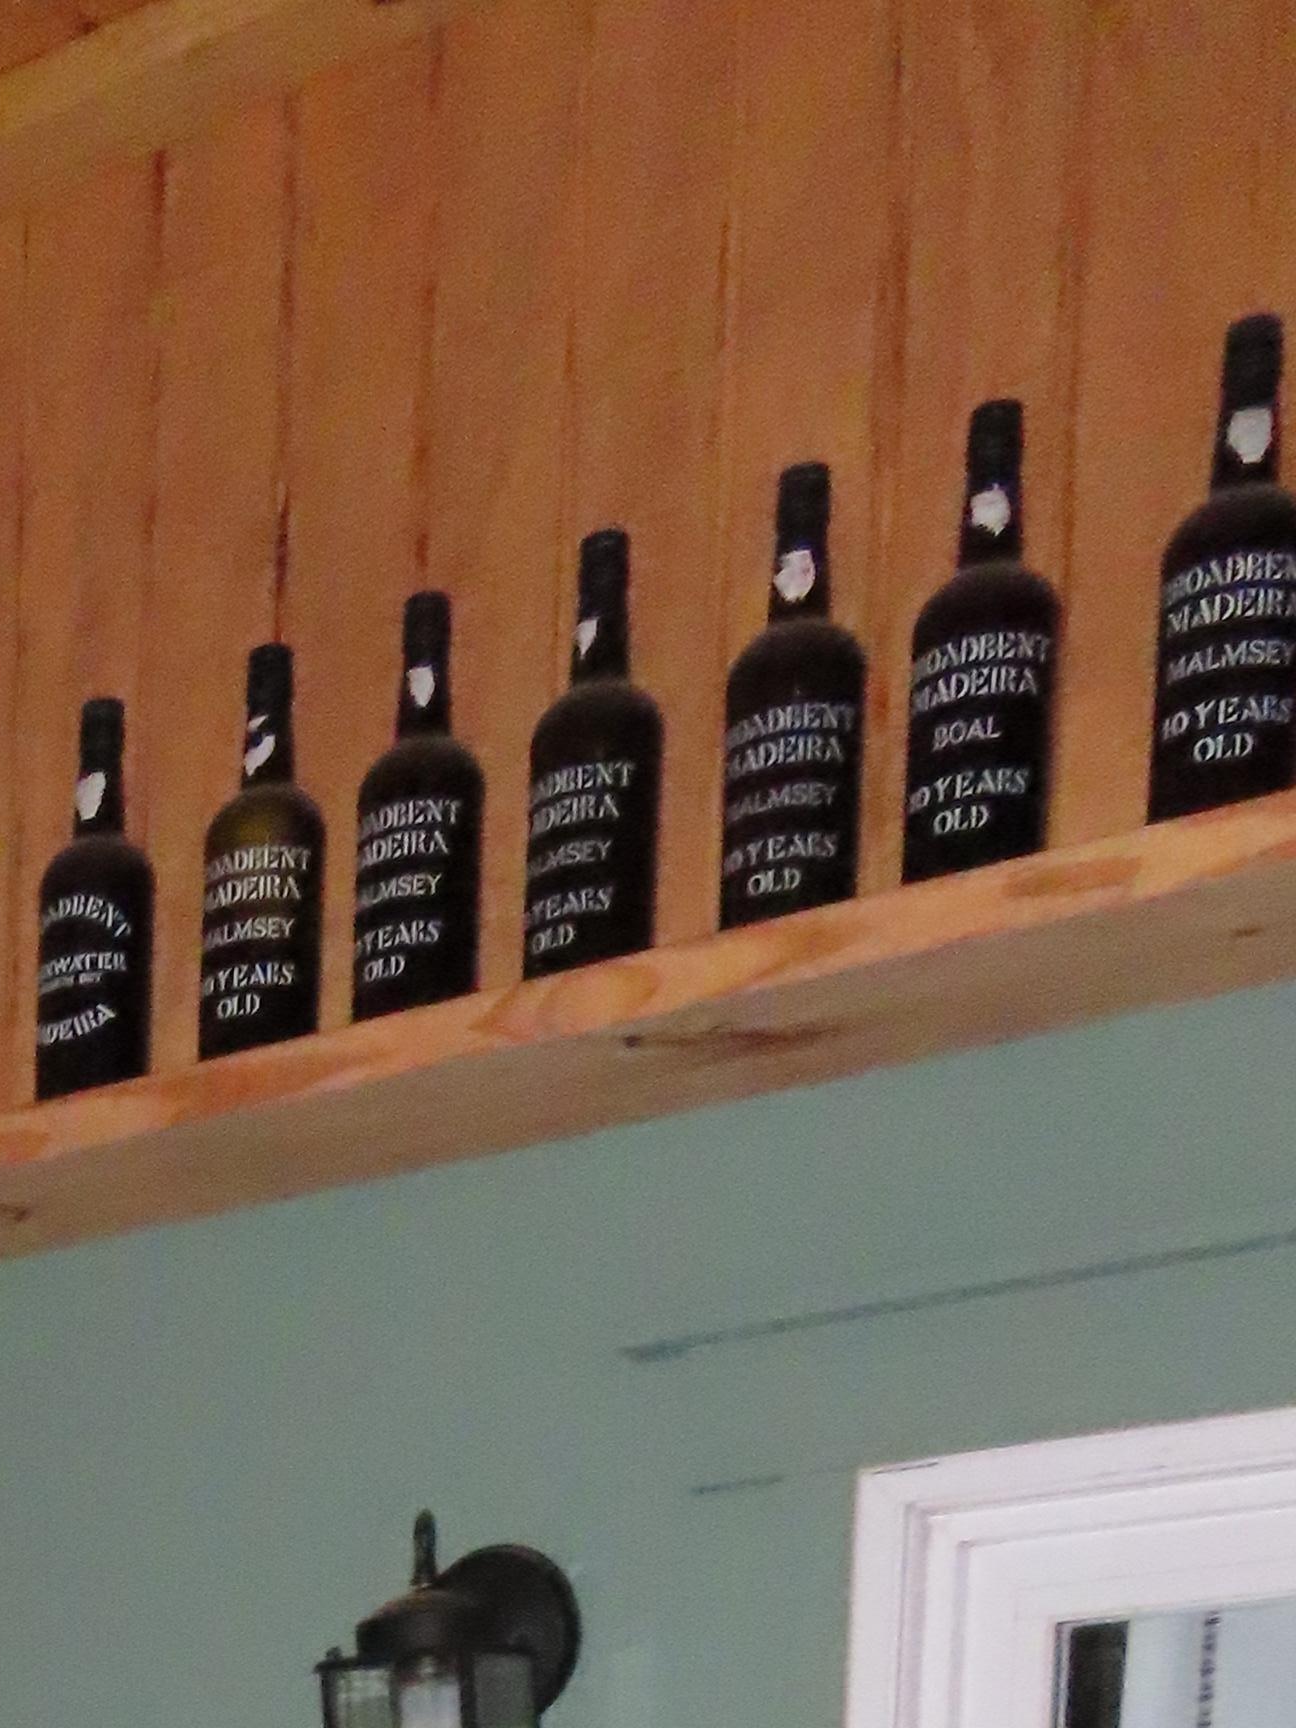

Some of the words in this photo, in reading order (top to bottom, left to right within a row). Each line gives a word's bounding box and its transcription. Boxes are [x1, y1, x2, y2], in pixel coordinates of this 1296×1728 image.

[913, 631, 1051, 685] OADBENT
[727, 702, 856, 748] OADBENT
[1194, 694, 1294, 729] YEARS
[933, 715, 1002, 751] BOAL
[1193, 732, 1255, 762] OLD
[909, 786, 931, 813] 0
[933, 766, 1029, 803] YEARS
[533, 792, 620, 836] DEIRA
[933, 804, 990, 835] OLD
[208, 844, 312, 881] OADBENT
[358, 829, 450, 869] ADEIRA
[746, 830, 837, 866] YEARS
[746, 867, 802, 896] OLD
[363, 918, 442, 957] YEARS
[532, 922, 576, 954] OLD
[216, 961, 295, 994] YEARS
[363, 954, 406, 982] OLD
[217, 992, 261, 1019] OLD
